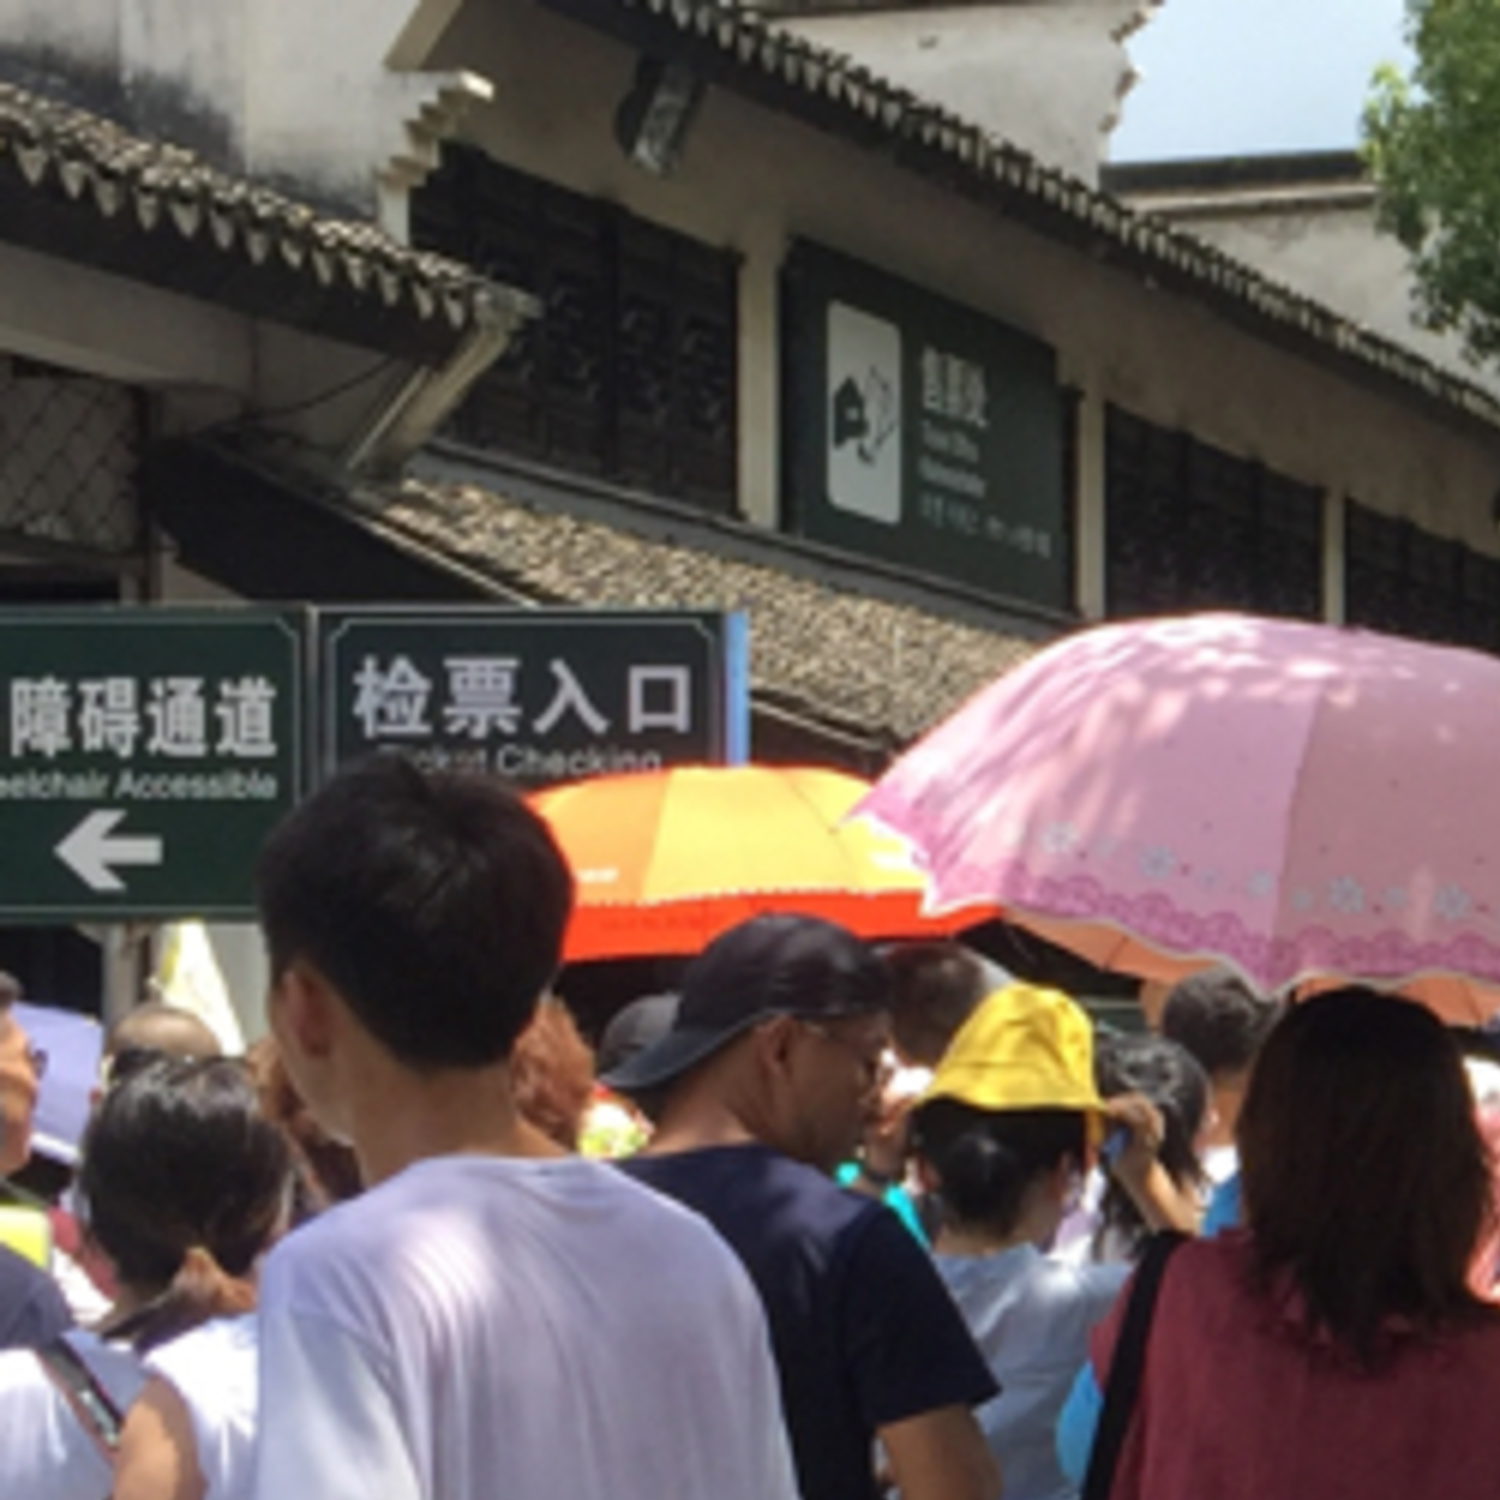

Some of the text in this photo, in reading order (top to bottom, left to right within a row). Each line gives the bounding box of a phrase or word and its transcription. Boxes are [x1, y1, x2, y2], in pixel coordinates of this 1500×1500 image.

[10, 675, 278, 758] 障碍通道
[352, 655, 691, 739] 检票入口
[114, 769, 278, 799] Accessible
